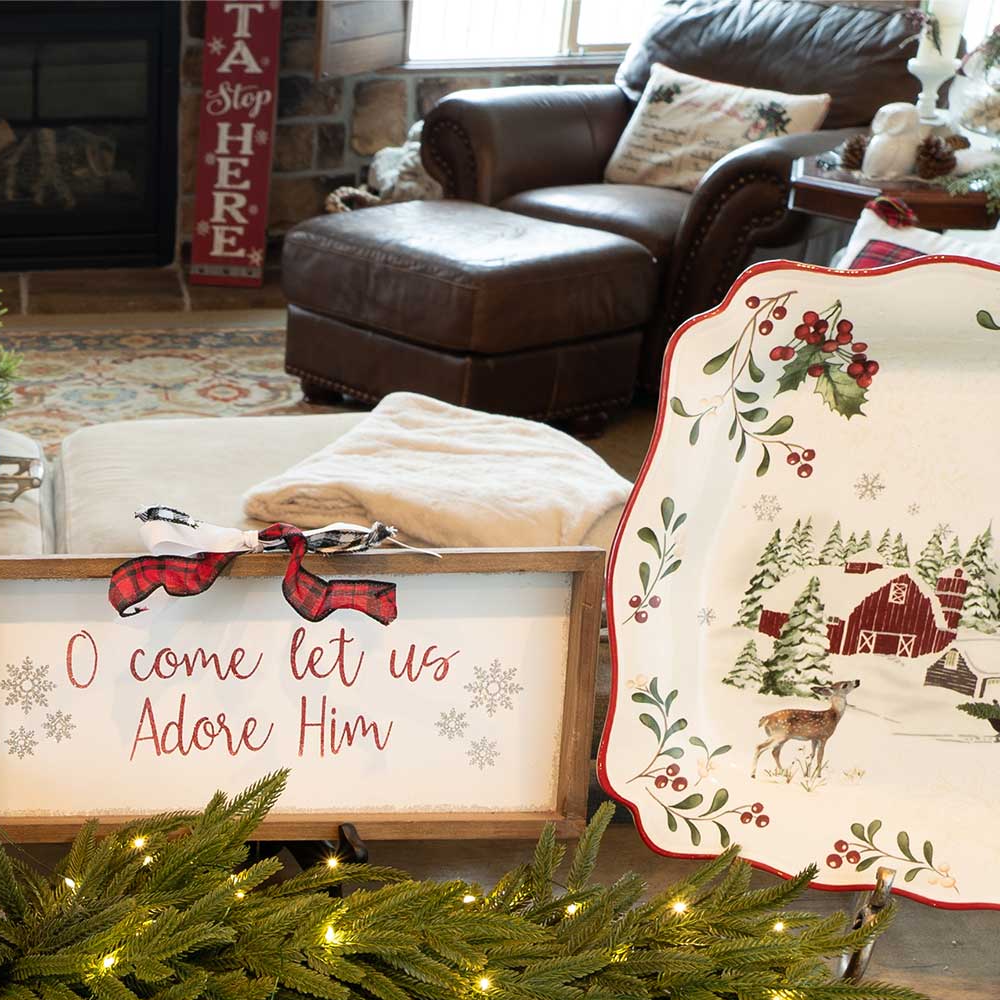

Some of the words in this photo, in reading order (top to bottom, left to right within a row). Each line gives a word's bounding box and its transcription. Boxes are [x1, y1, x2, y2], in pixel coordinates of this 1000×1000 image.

[206, 81, 272, 118] Stop
[209, 122, 255, 258] HERE
[66, 630, 98, 689] O
[129, 646, 264, 681] come
[289, 626, 365, 687] let
[390, 643, 461, 682] us
[129, 693, 274, 761] Adore
[298, 695, 394, 758] Him
